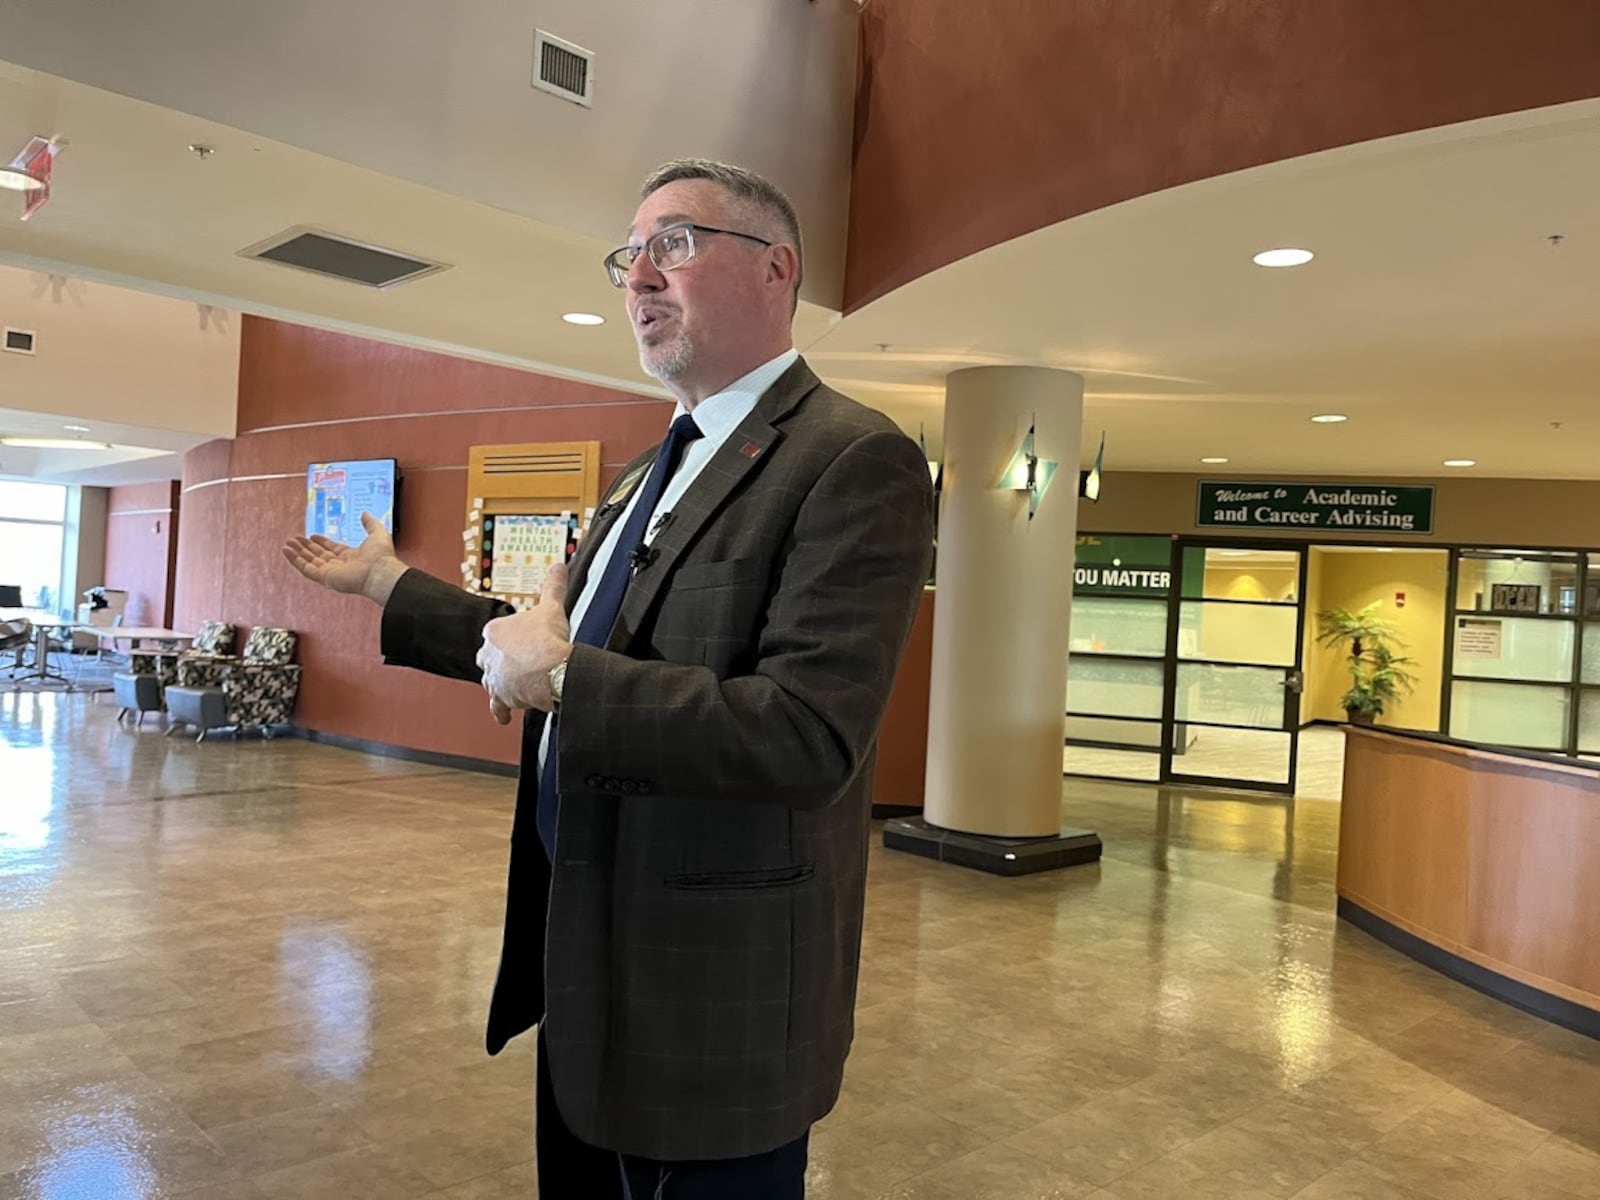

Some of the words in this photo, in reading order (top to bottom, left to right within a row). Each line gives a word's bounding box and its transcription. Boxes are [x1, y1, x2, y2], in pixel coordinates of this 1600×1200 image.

[1215, 489, 1270, 502] Welcome
[1273, 488, 1287, 499] to
[1302, 488, 1398, 506] Academic
[1213, 506, 1248, 521] and
[1254, 506, 1320, 524] Career
[1326, 509, 1415, 530] Advising
[510, 527, 552, 535] MENTAL
[510, 536, 552, 544] HEALTH
[500, 544, 560, 552] AWARENESS
[1073, 568, 1098, 585] OU
[1102, 569, 1171, 588] MATTER
